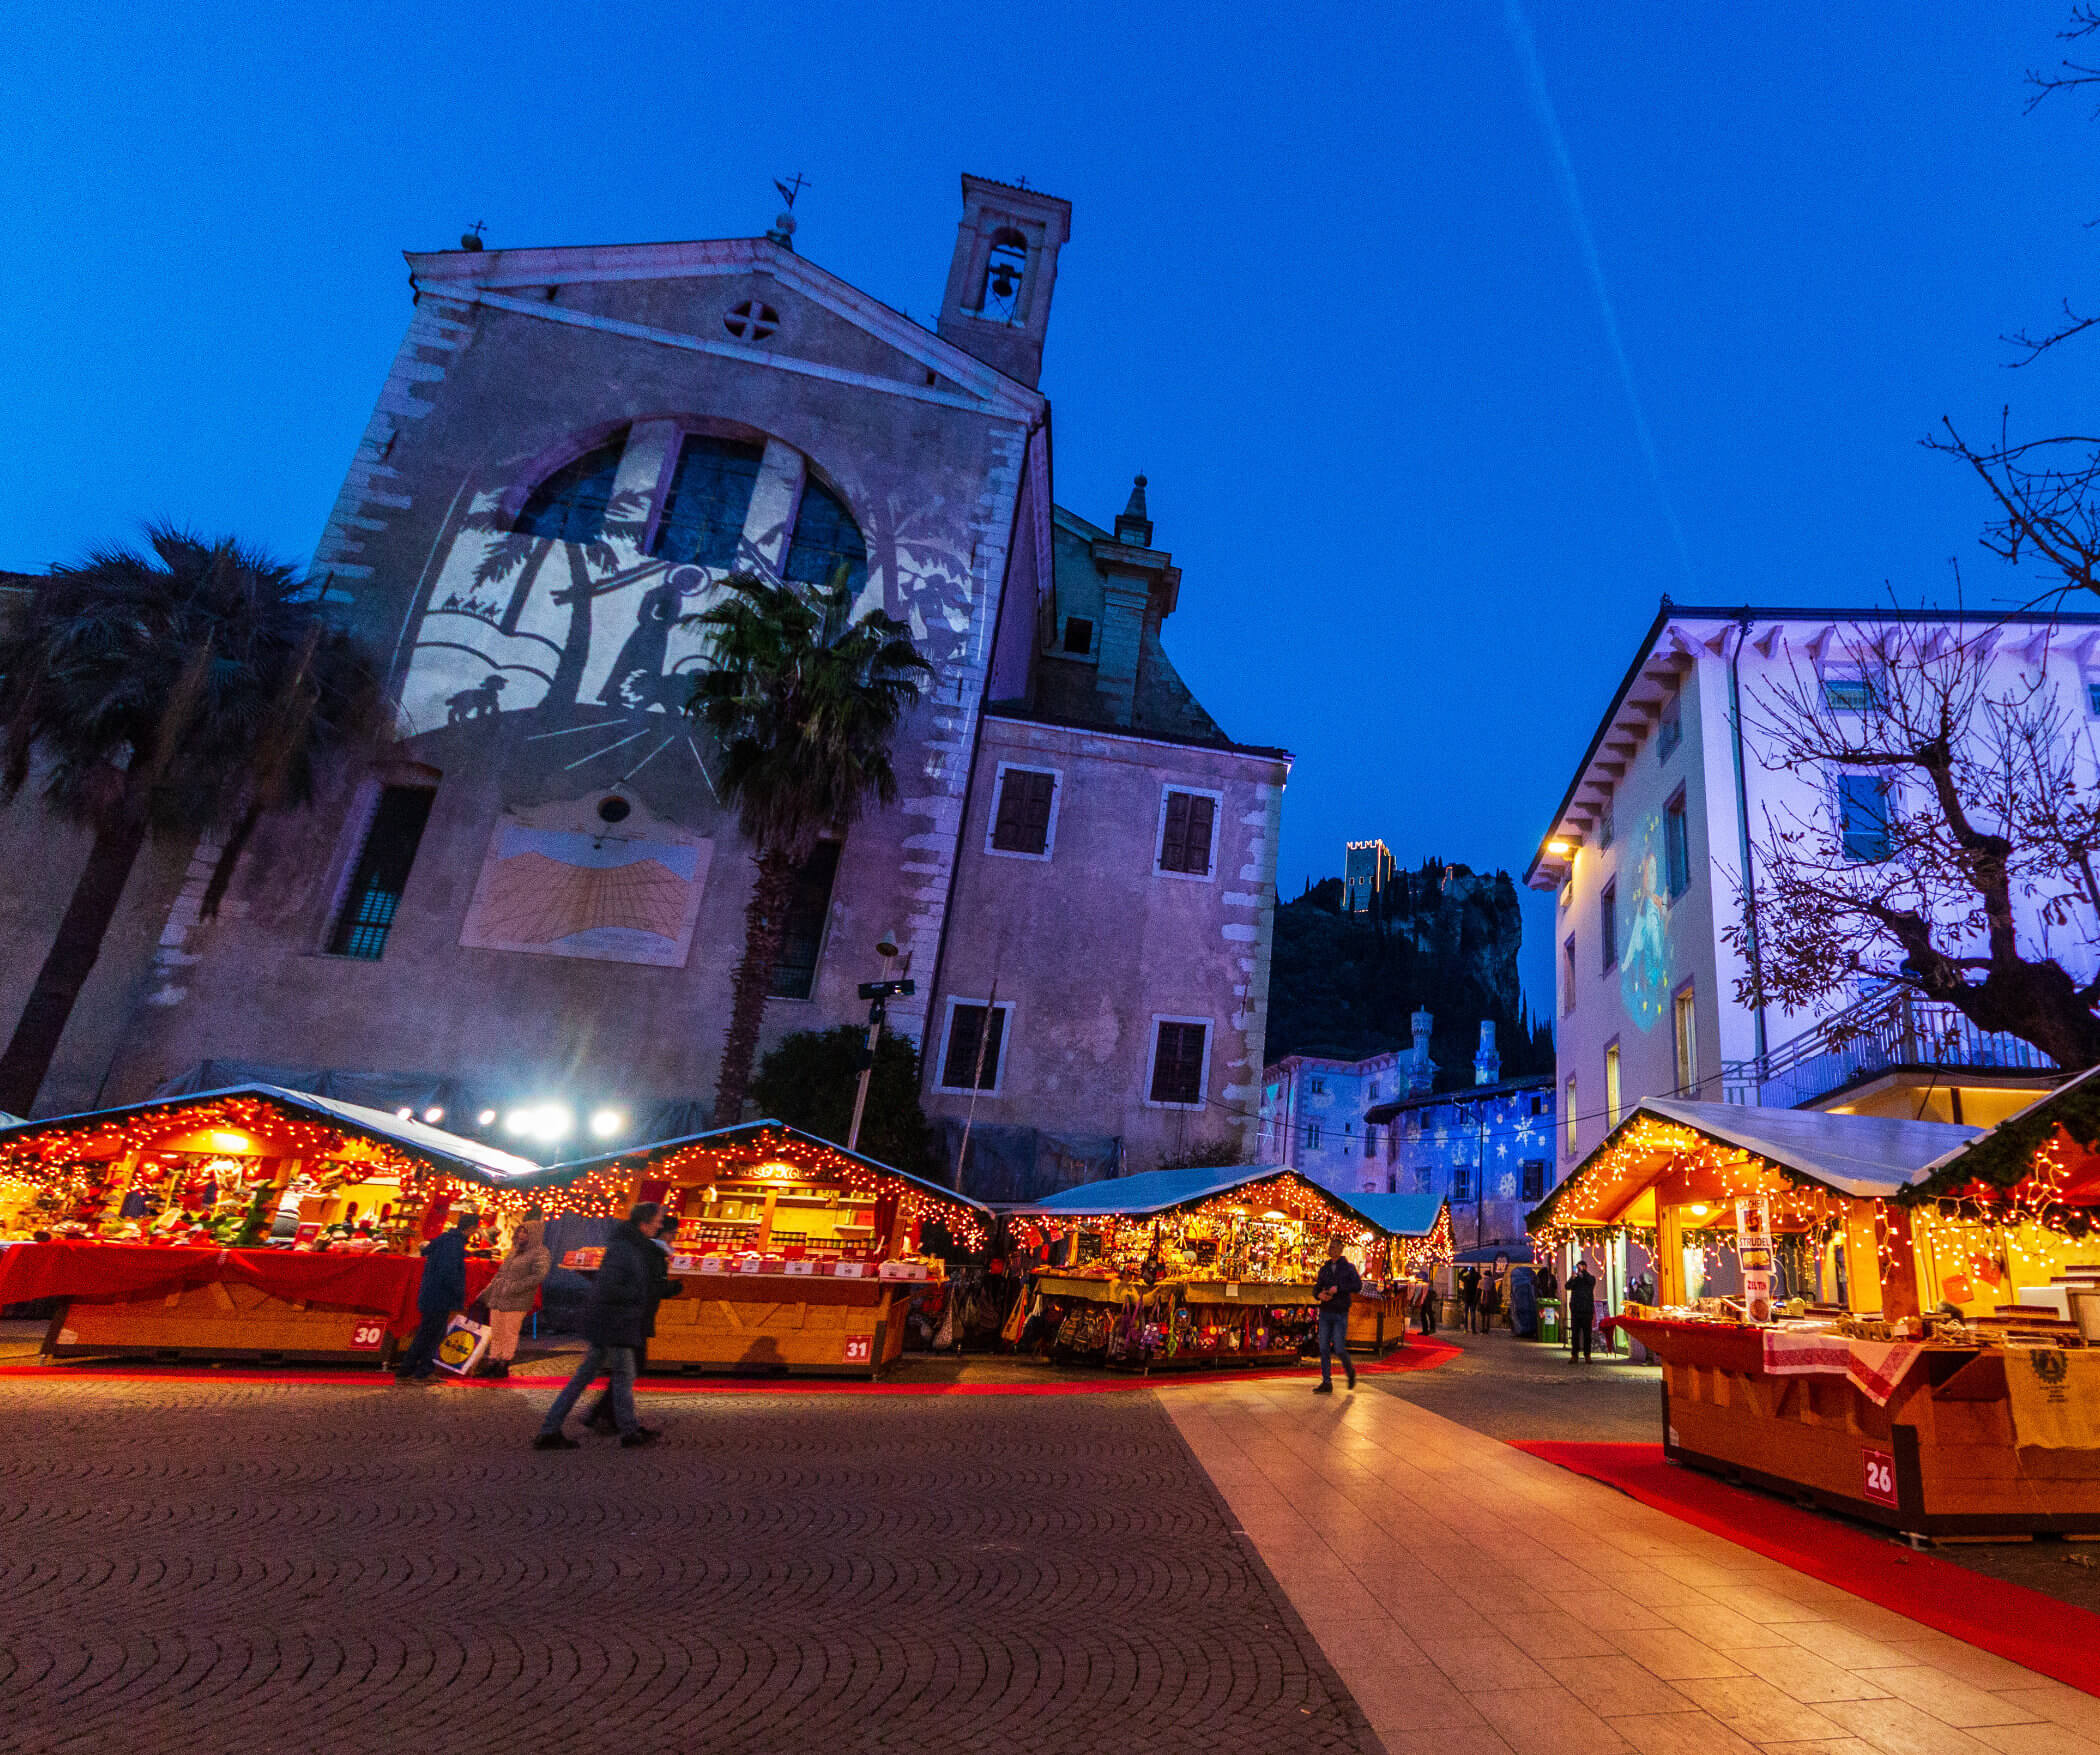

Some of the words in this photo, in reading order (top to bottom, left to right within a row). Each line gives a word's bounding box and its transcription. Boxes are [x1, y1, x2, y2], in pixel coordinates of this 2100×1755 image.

[1740, 1199, 1765, 1210] ACHER
[1739, 1237, 1770, 1247] STRUDEL
[355, 1327, 381, 1343] 30
[847, 1341, 868, 1357] 31
[1866, 1461, 1892, 1493] 26
